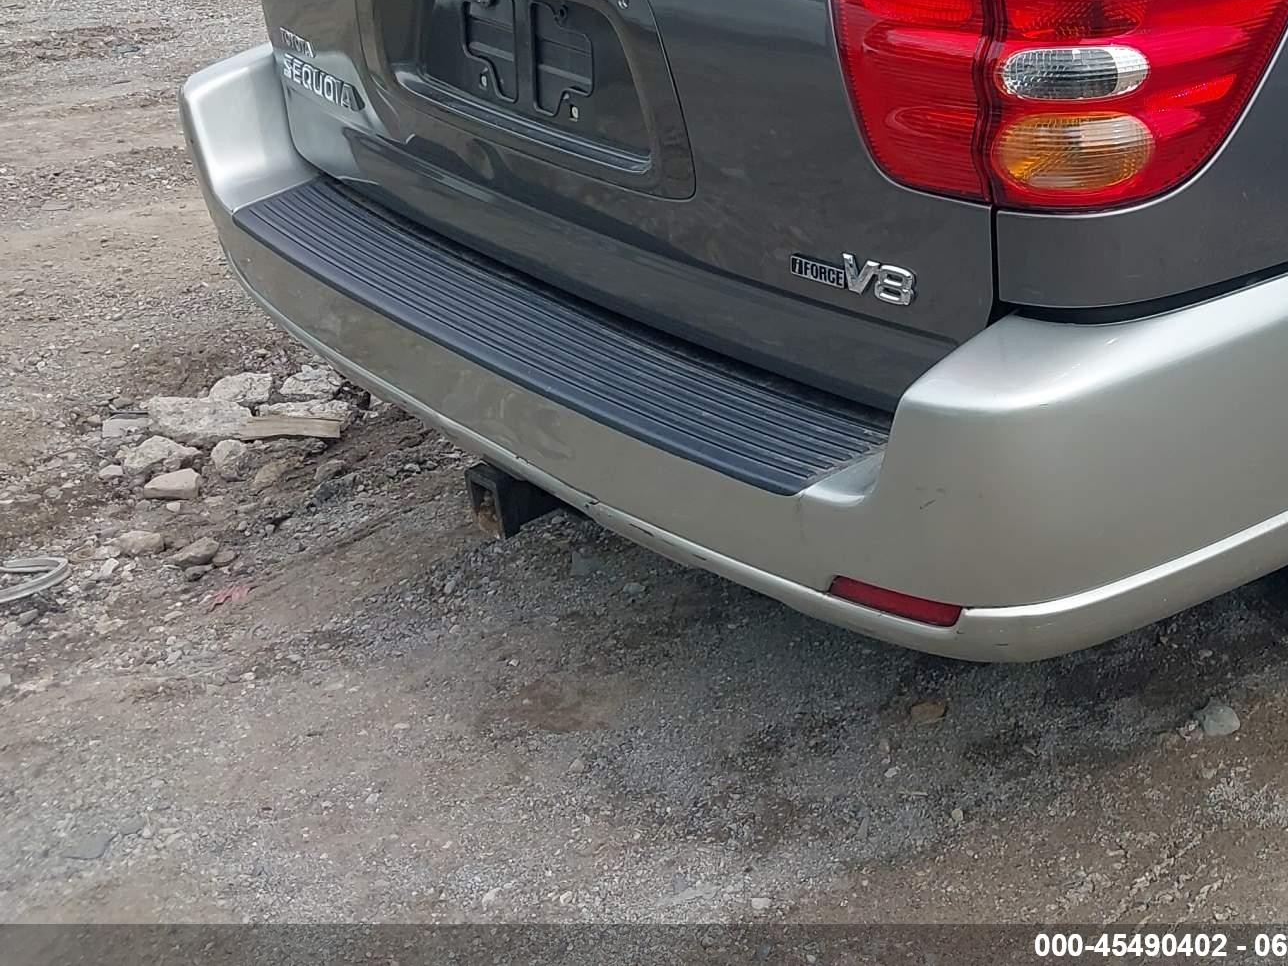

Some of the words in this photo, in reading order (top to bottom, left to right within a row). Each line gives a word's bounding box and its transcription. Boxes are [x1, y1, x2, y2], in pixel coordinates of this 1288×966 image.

[280, 27, 315, 59] TOYOTA
[283, 53, 363, 111] SEQUOIA
[842, 252, 915, 306] V8
